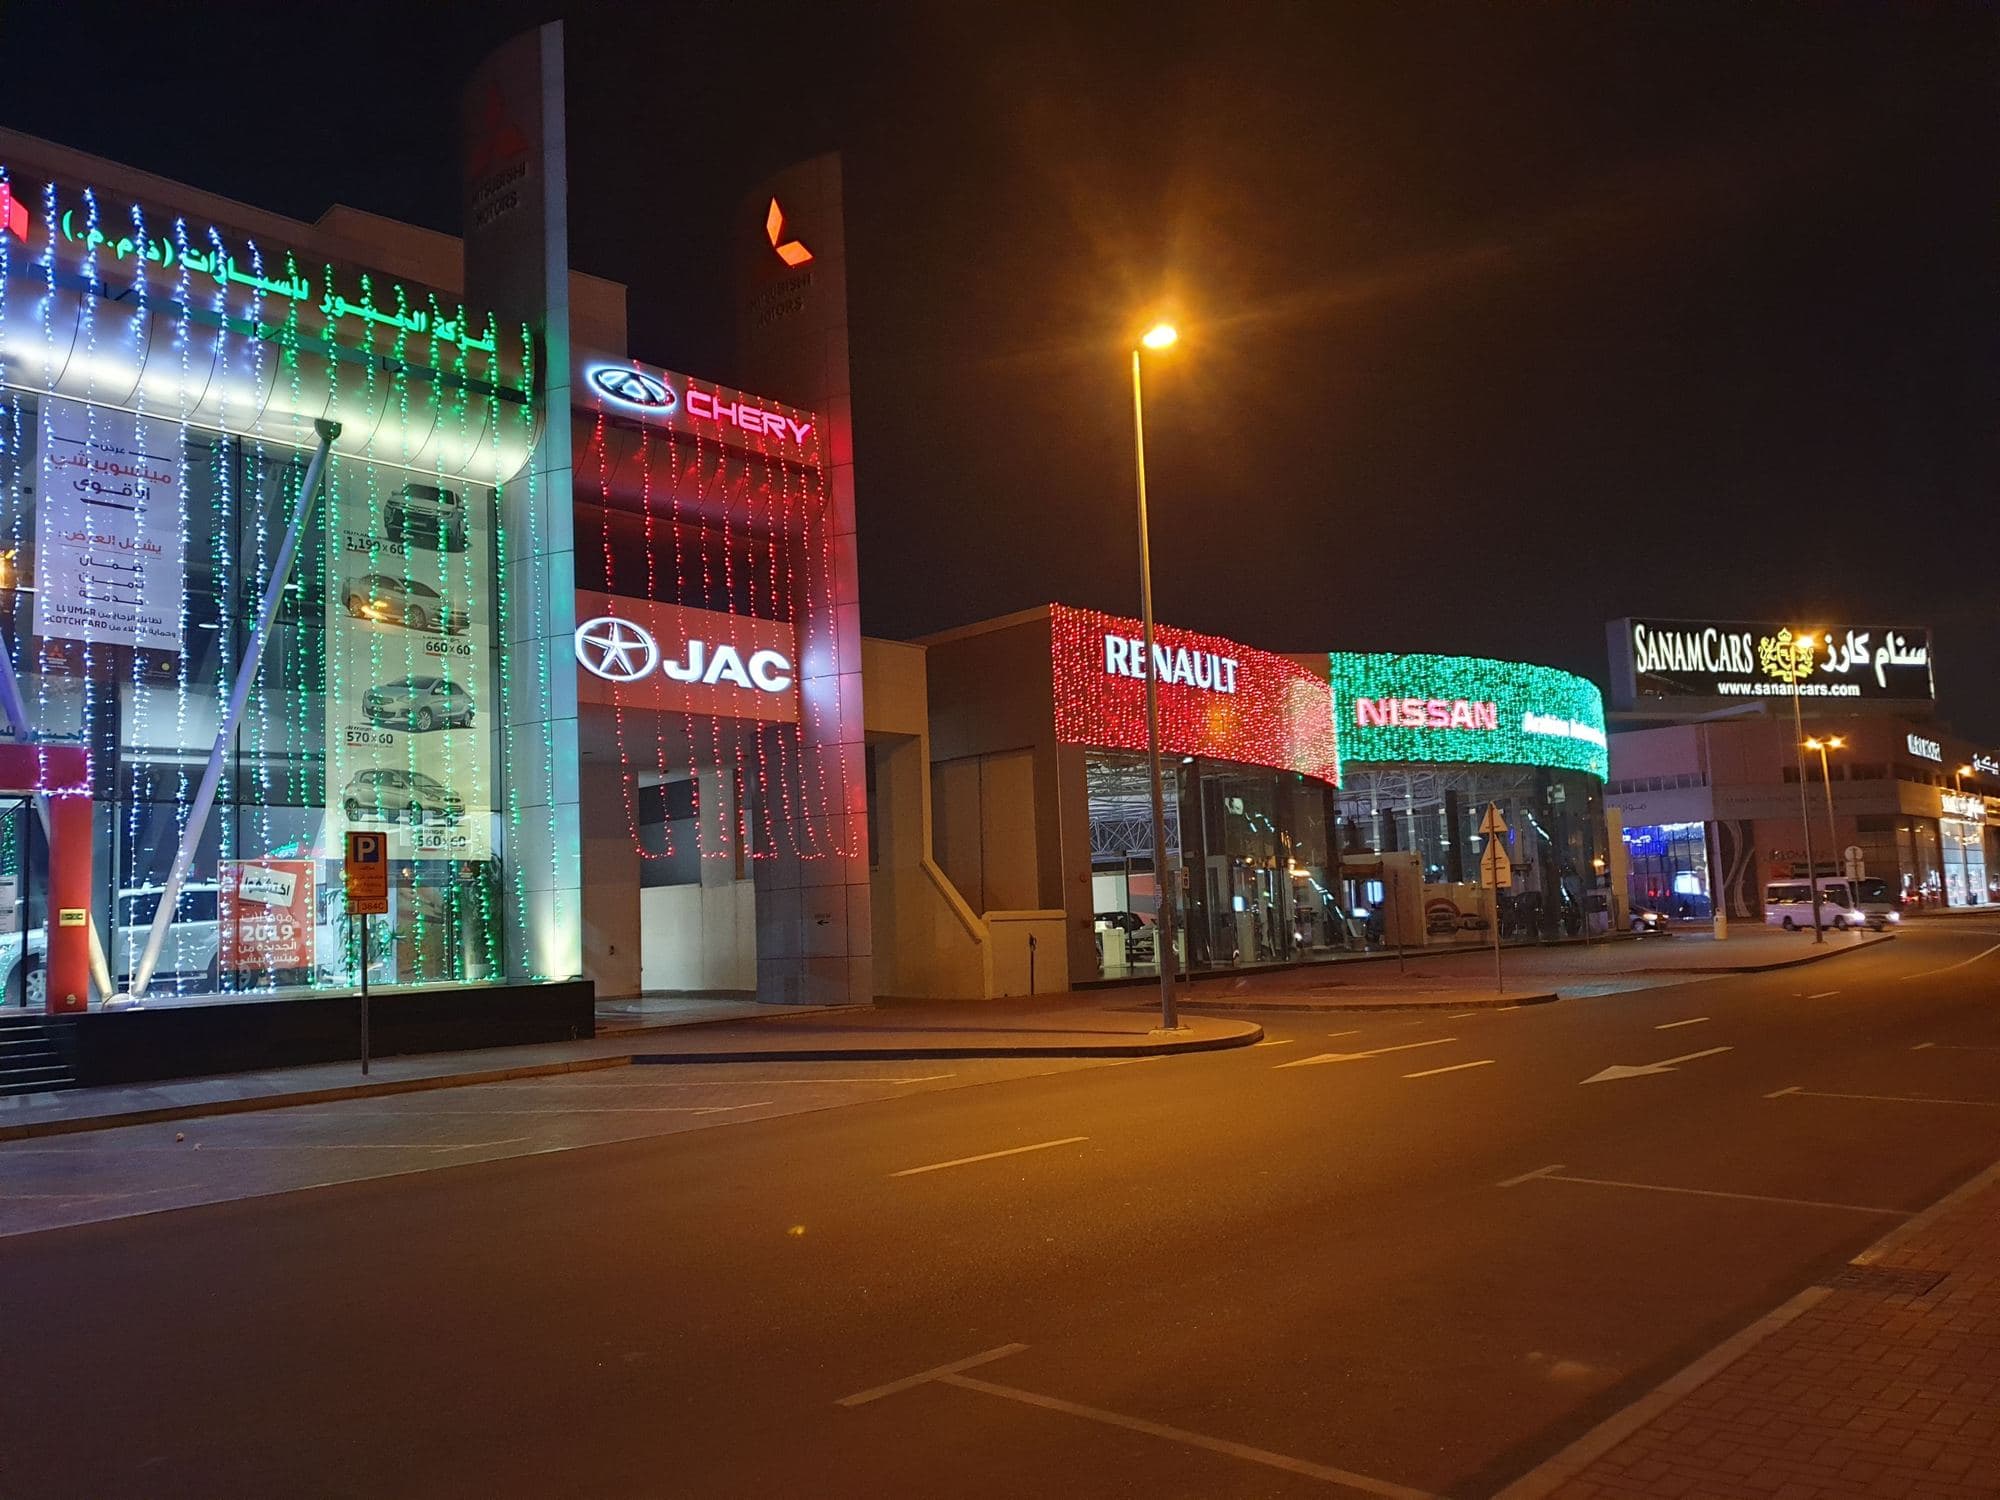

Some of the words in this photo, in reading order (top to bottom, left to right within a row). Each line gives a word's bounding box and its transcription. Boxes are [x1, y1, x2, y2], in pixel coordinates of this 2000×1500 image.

[686, 388, 811, 445] CHERY
[425, 641, 448, 653] 660
[456, 644, 471, 656] 60
[1820, 629, 1870, 673] كارز
[1874, 631, 1927, 689] سنام
[663, 639, 792, 693] JAC
[1104, 634, 1238, 695] RENAULT
[1718, 682, 1861, 697] www.sanamcars.com
[1356, 697, 1499, 731] NISSAN
[347, 731, 369, 743] 570
[378, 733, 394, 744] 60
[358, 837, 376, 862] P
[417, 835, 441, 847] 560
[242, 924, 295, 942] 2019
